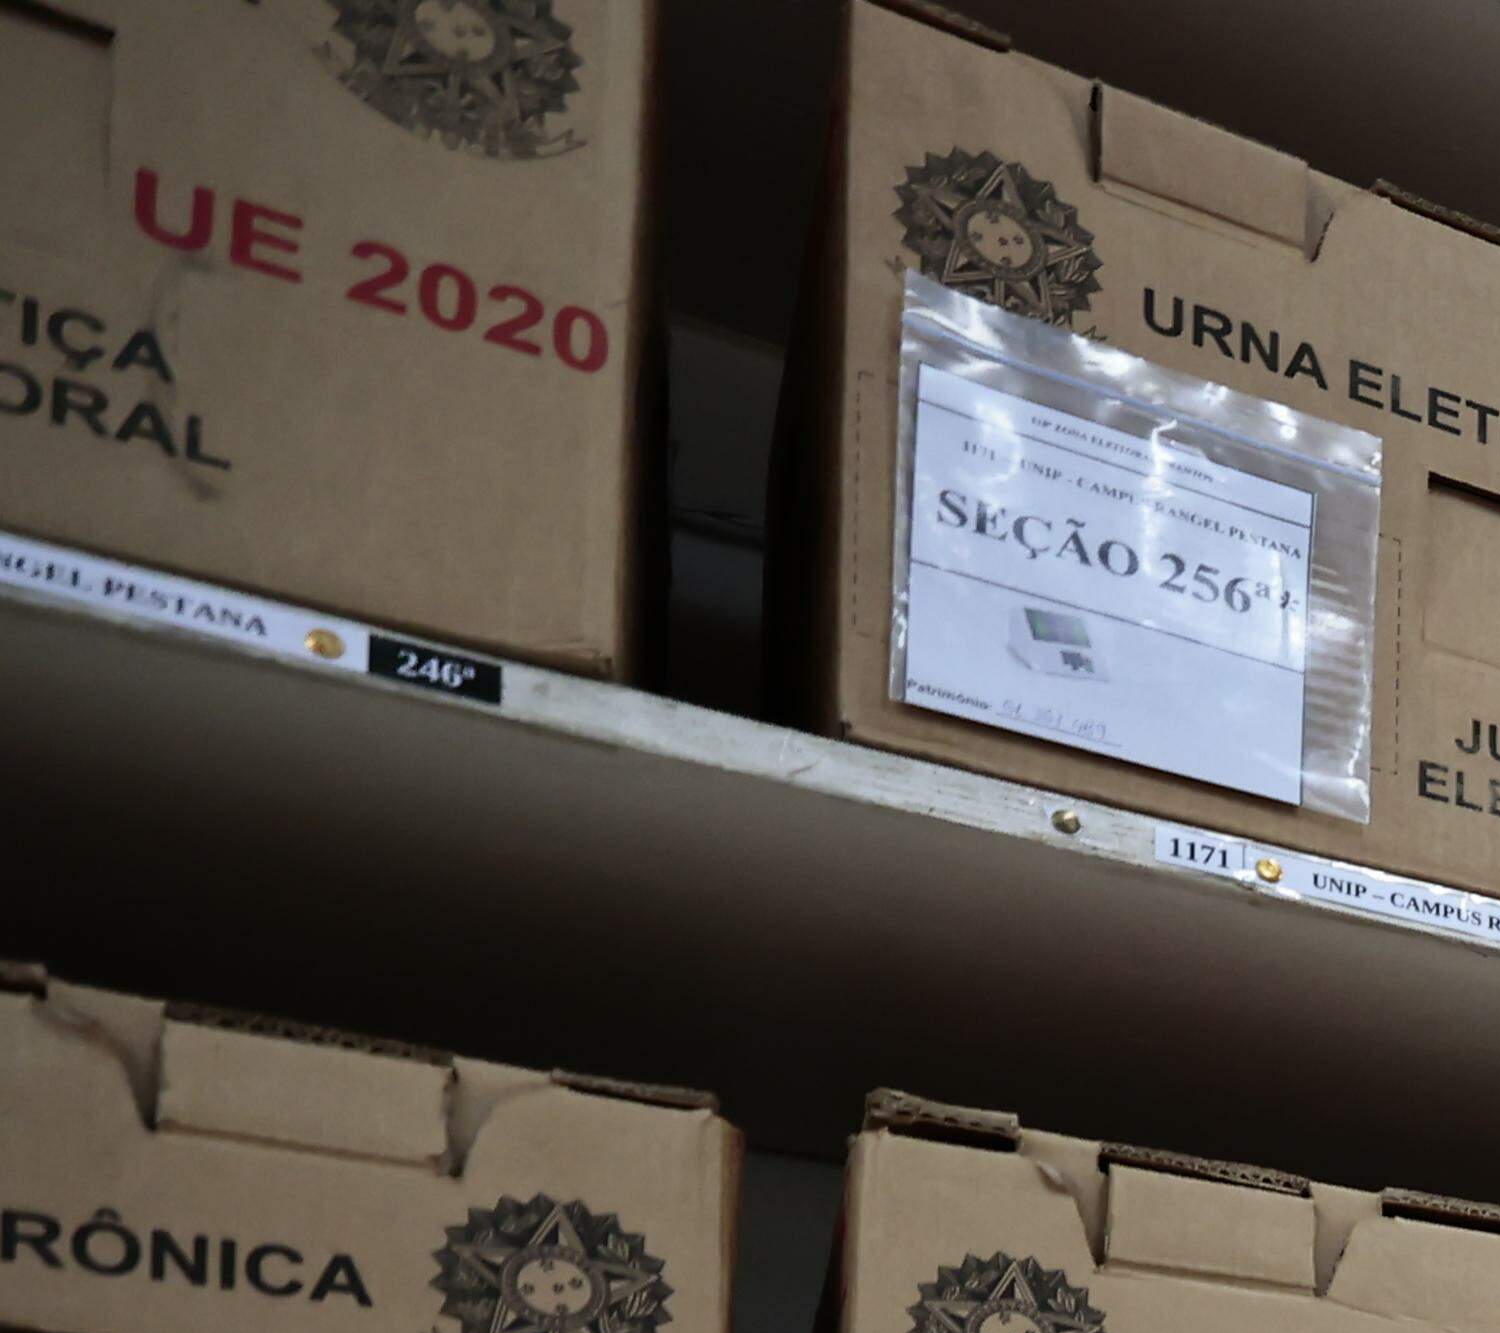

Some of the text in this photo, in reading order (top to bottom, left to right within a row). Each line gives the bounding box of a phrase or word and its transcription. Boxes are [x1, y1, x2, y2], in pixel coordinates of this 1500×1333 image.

[134, 166, 609, 373] UE 2020
[1143, 286, 1328, 391] URNA
[936, 488, 1140, 577] SEÇÃO
[1167, 834, 1231, 872] 1171
[1313, 873, 1368, 902] UNIP
[1390, 889, 1483, 928] CAMPUS
[0, 1207, 374, 1308] RÔNICA
